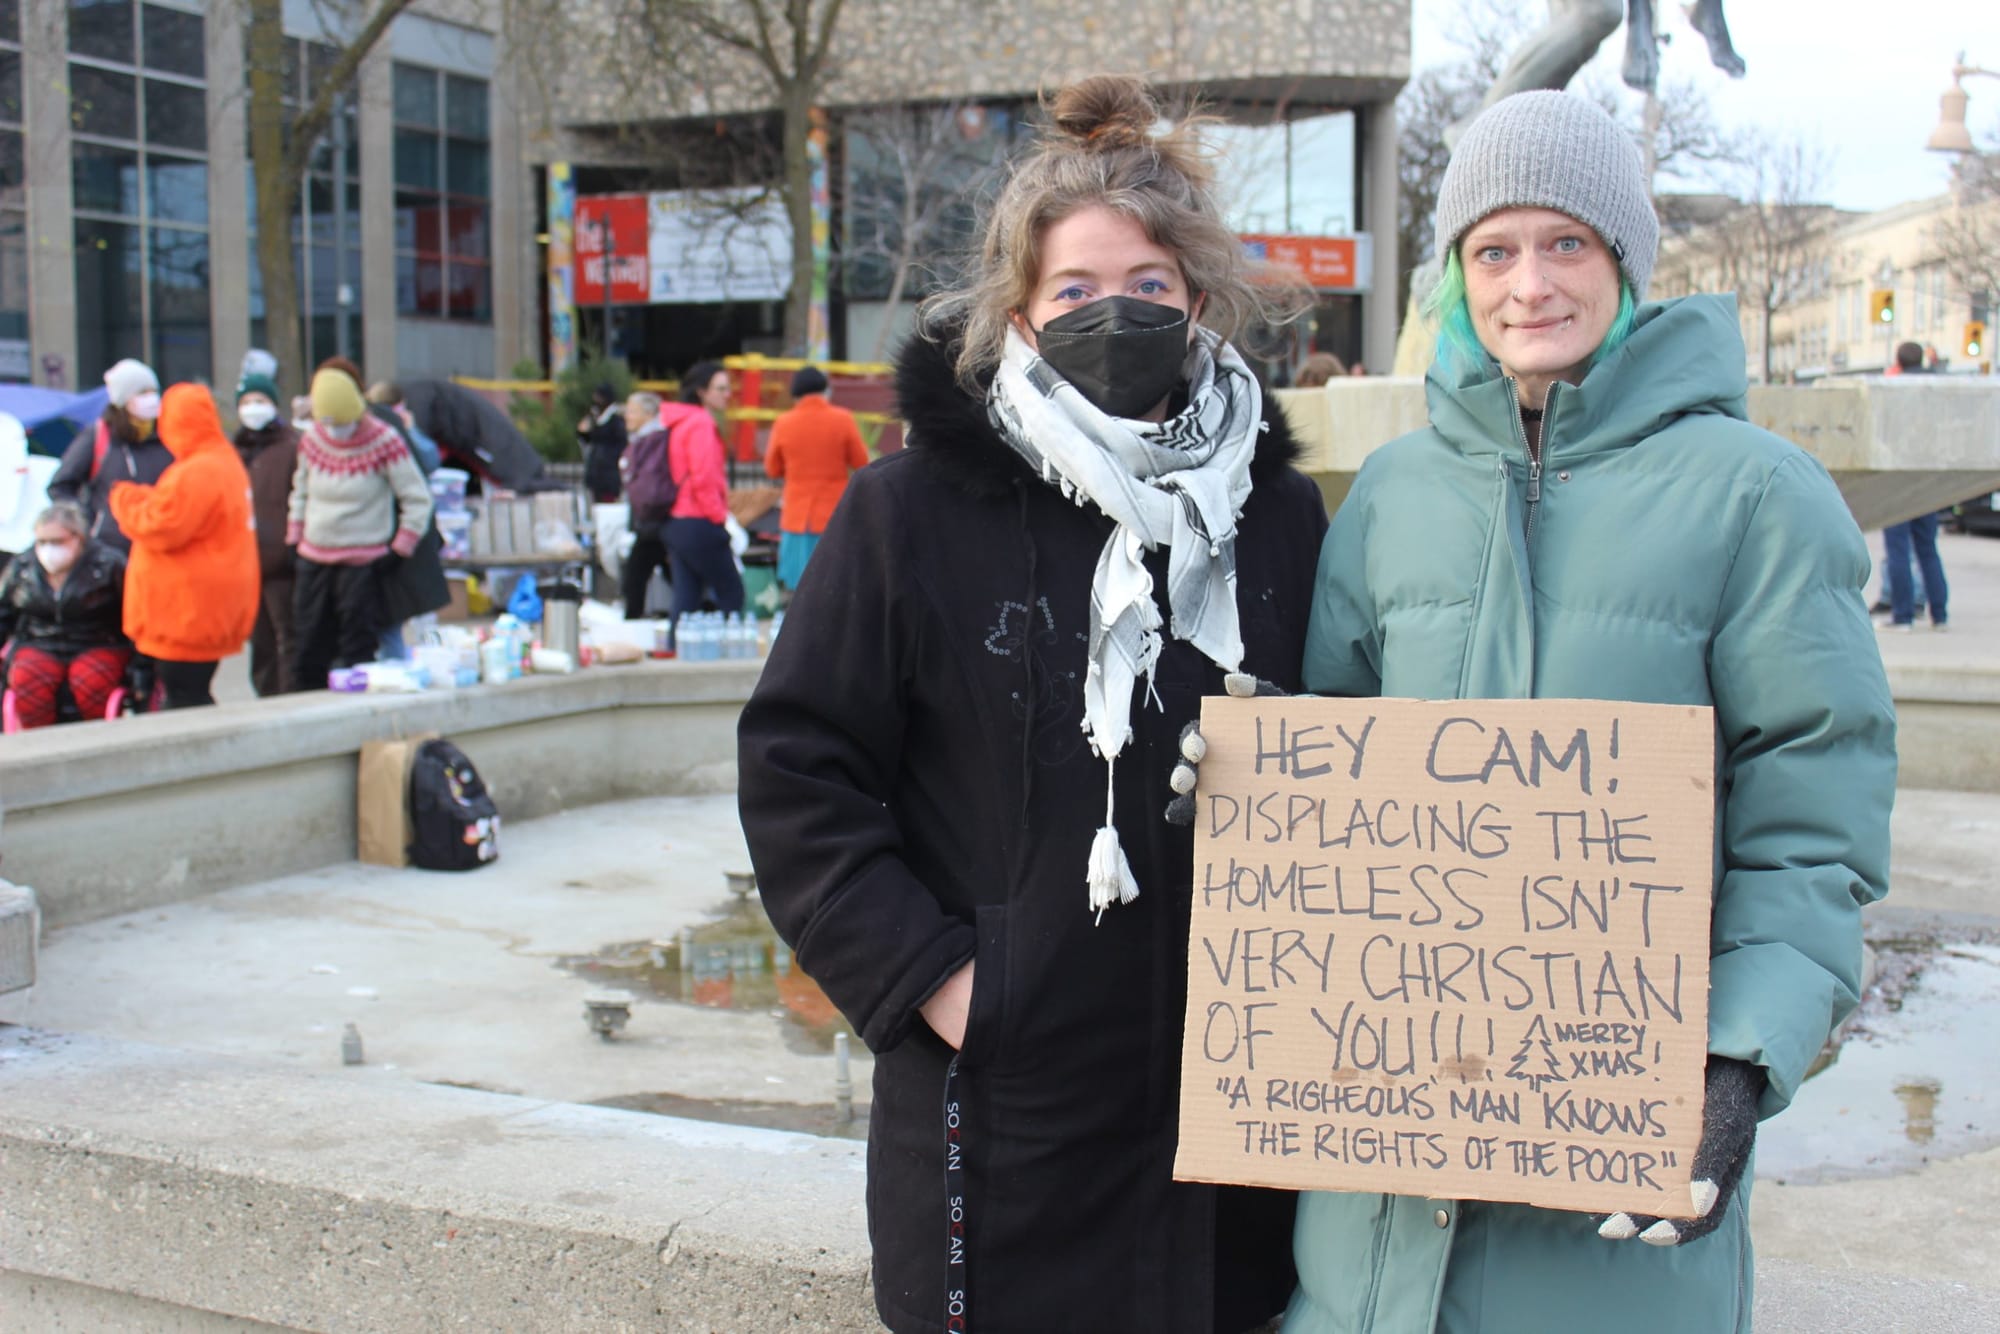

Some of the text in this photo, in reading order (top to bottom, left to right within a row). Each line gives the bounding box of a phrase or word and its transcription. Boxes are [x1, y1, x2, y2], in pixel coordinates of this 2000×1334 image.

[1256, 717, 1618, 795] HEY CAM!
[1208, 792, 1656, 864] DISPLACING THE
[1204, 857, 1683, 947] HOMELESS ISN'T
[1204, 929, 1682, 1024] VERY CHRISTIAN
[1205, 1002, 1493, 1083] OF YOU!!!
[1554, 1022, 1646, 1053] MERRY
[1569, 1040, 1661, 1082] XMAS!
[947, 1102, 961, 1170] SOCAN
[1217, 1077, 1250, 1108] "A
[1451, 1088, 1520, 1124] MAN
[1544, 1090, 1666, 1137] KNOWS
[1237, 1122, 1676, 1190] THE RIGHTS OF THE POOR"
[950, 1197, 963, 1264] SOCAN
[948, 1290, 965, 1334] SOC
